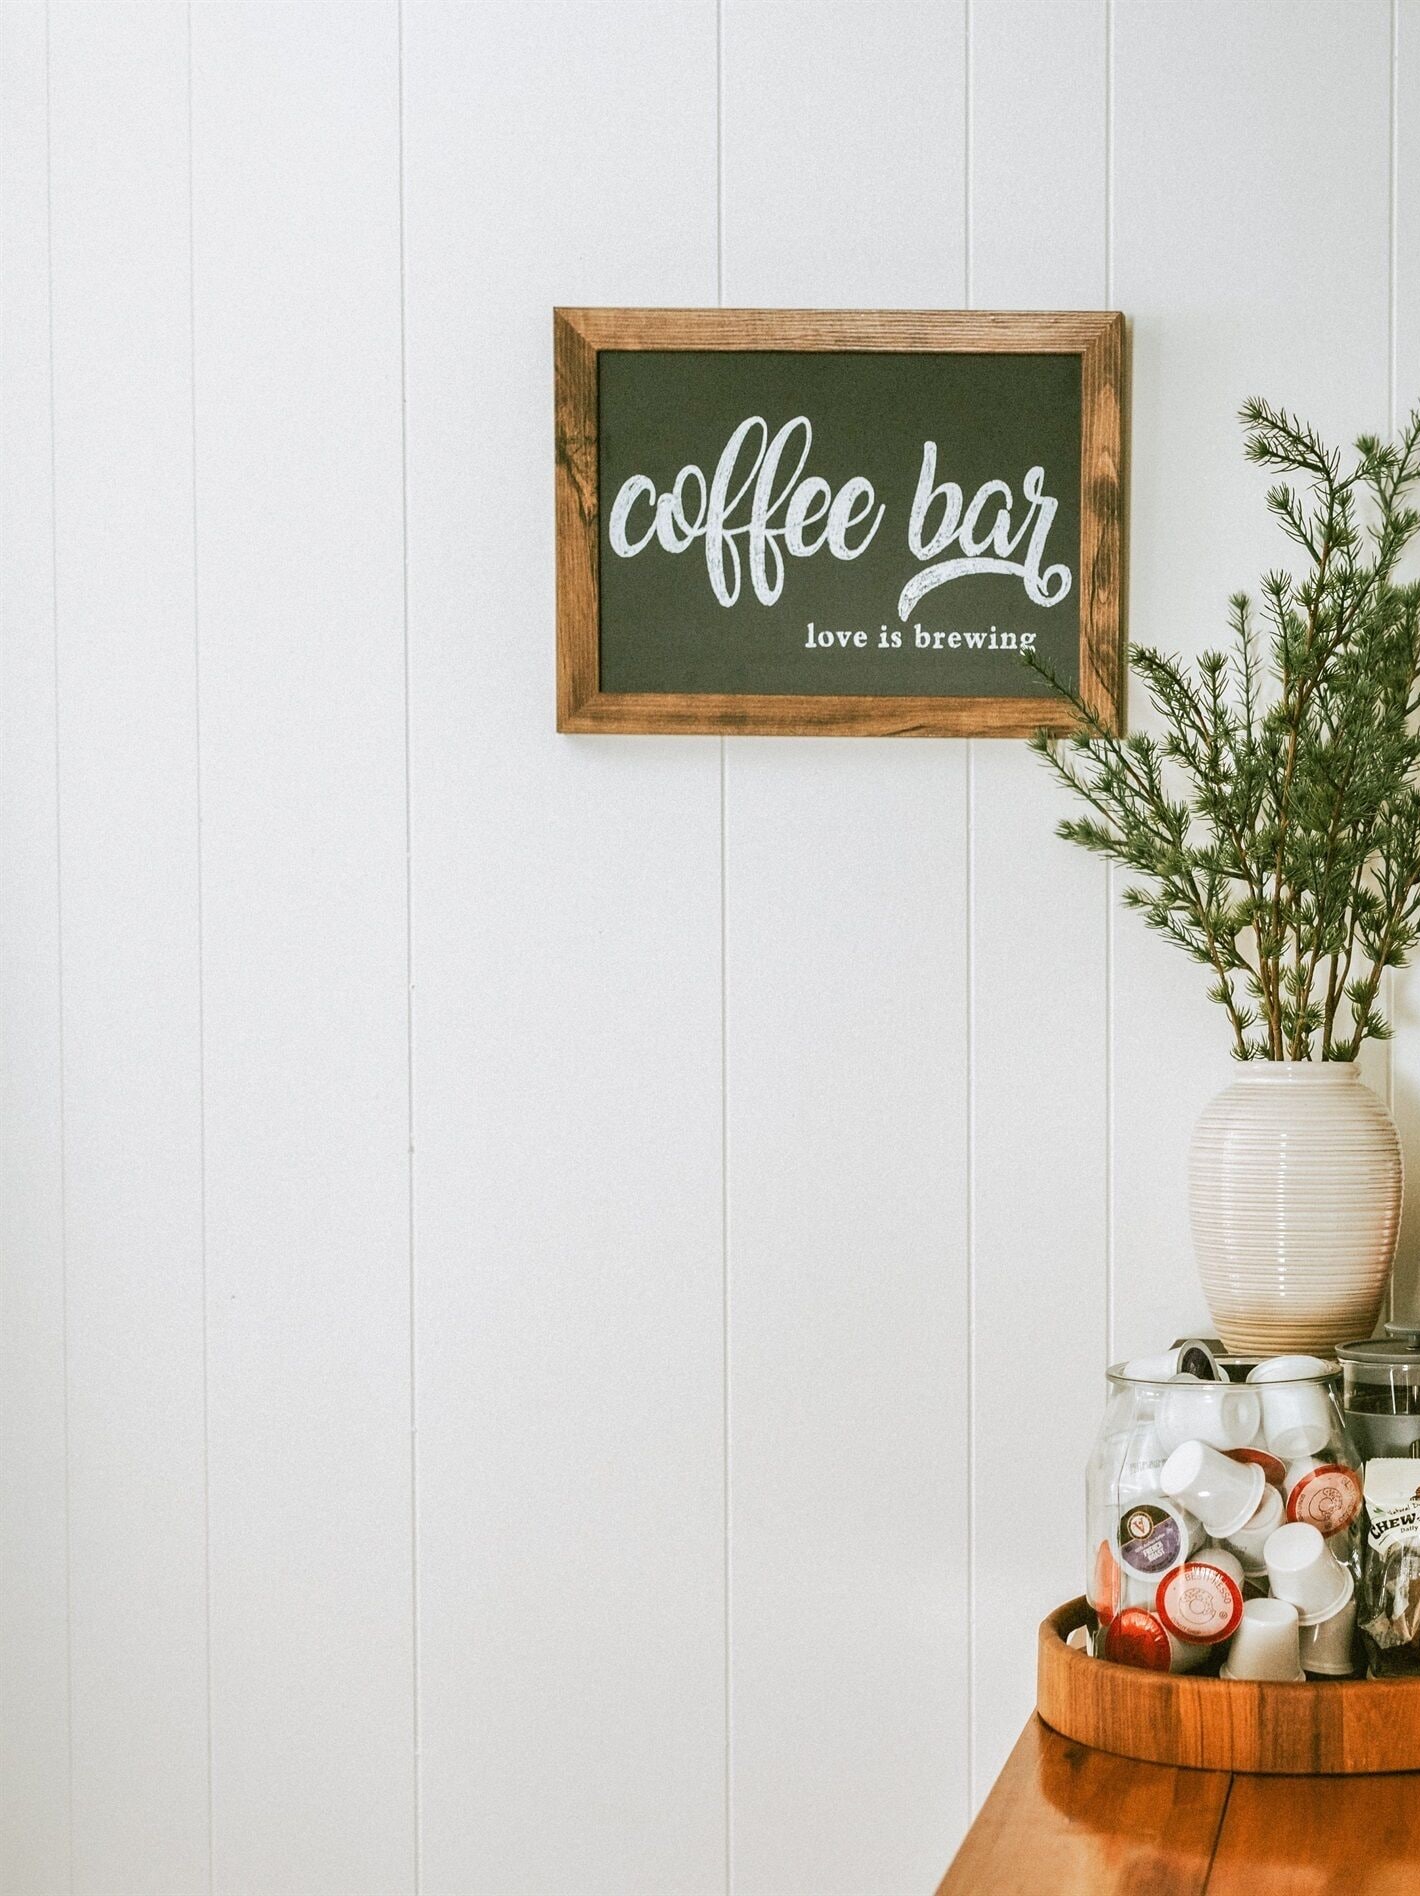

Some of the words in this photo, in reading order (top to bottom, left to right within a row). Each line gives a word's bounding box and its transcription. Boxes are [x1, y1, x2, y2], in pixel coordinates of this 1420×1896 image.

[609, 415, 886, 608] coffee
[898, 440, 1072, 622] bar
[804, 622, 868, 649] love
[877, 624, 903, 648] is
[914, 623, 1037, 656] brewing
[1400, 1525, 1419, 1534] Daily
